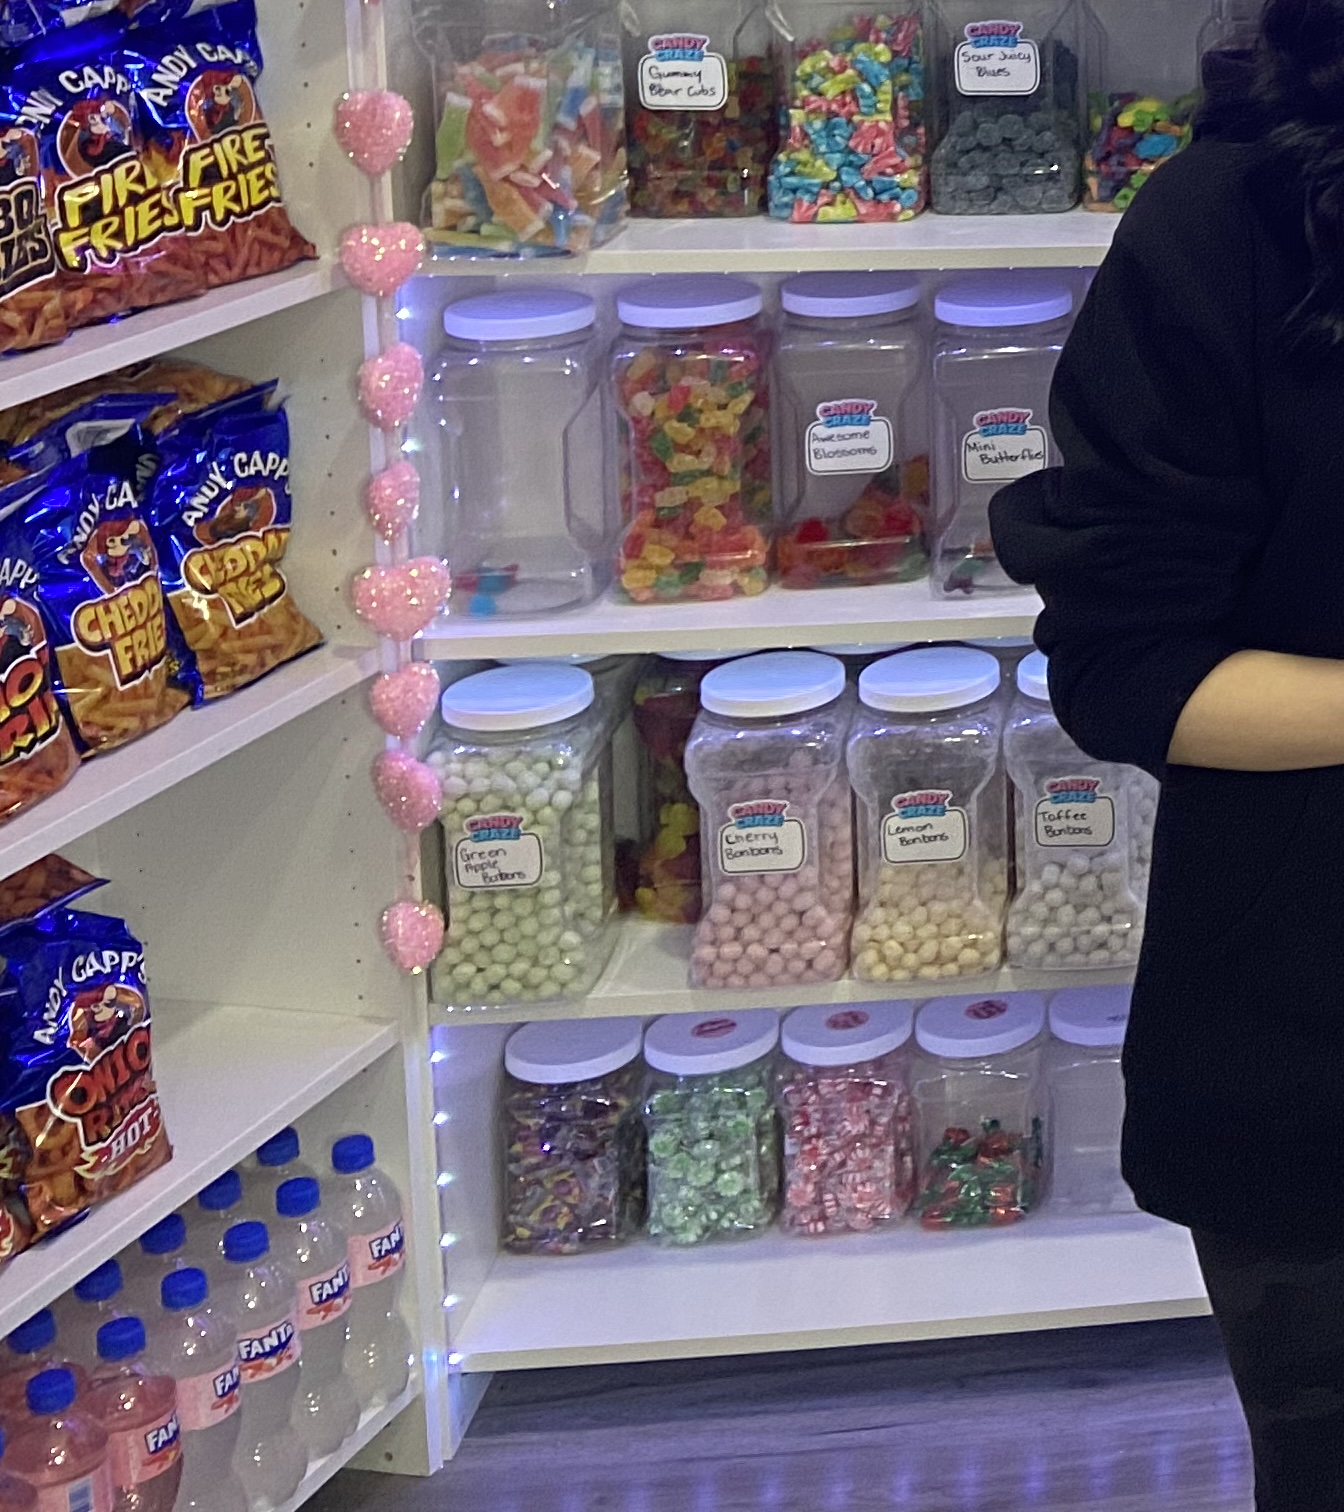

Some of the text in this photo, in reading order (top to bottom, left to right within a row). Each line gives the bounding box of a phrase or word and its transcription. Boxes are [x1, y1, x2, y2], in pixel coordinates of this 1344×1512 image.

[962, 50, 993, 63] Sour
[649, 65, 702, 82] Gummy
[810, 430, 871, 445] Awesome
[966, 442, 996, 456] Mini
[888, 821, 933, 837] Lemon
[109, 1116, 154, 1162] HOT
